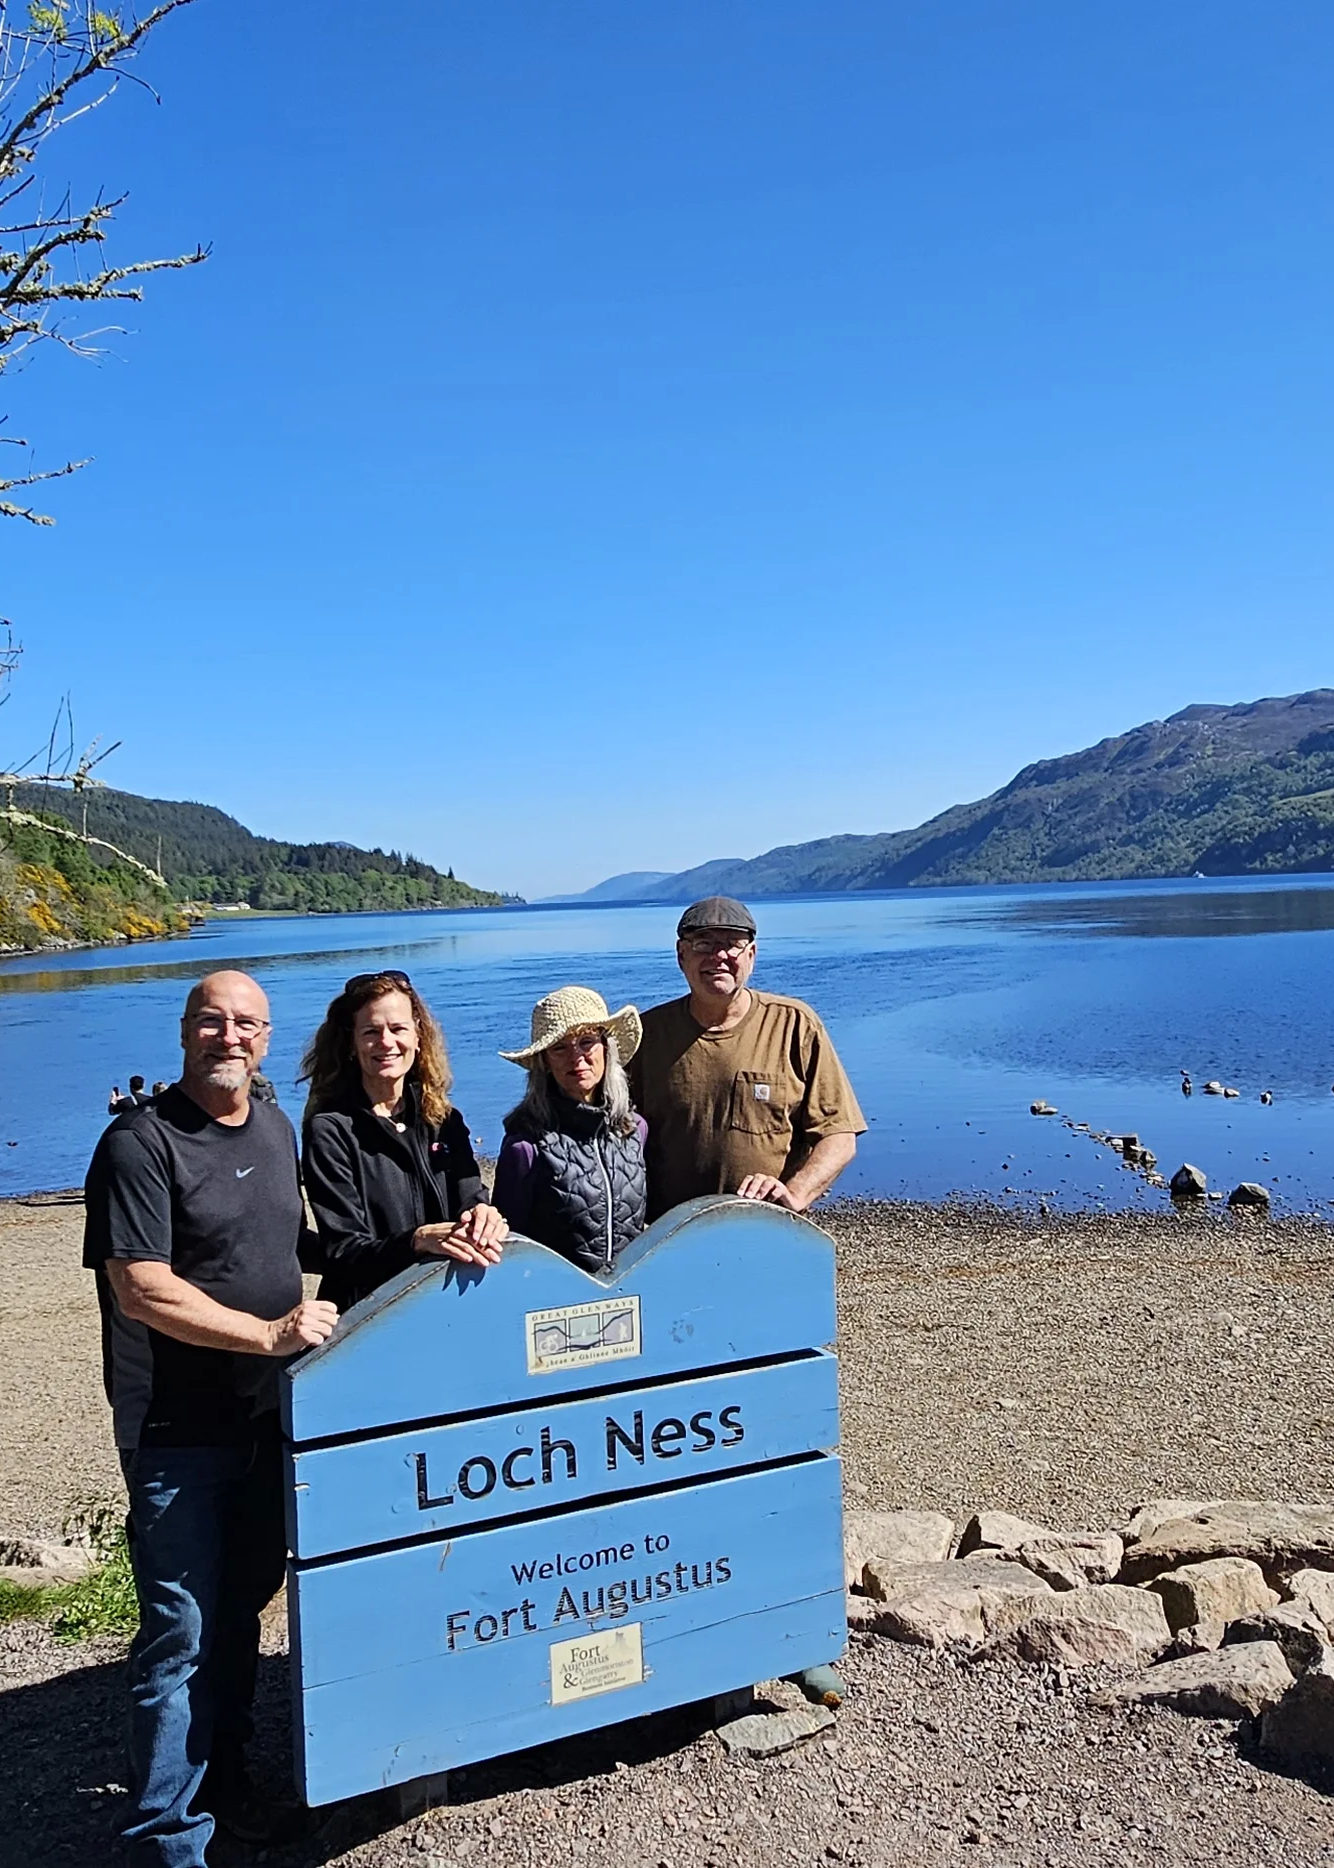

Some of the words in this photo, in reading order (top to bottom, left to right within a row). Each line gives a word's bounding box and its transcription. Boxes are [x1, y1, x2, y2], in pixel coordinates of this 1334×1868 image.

[532, 1310, 568, 1321] GREAT
[572, 1305, 601, 1315] GLEN
[606, 1300, 634, 1309] WAYS
[416, 1425, 577, 1511] Loch
[605, 1405, 746, 1471] Ness
[510, 1542, 635, 1586] Welcome
[643, 1533, 671, 1555] to
[446, 1599, 538, 1650] Fort
[552, 1557, 733, 1622] Augustus
[569, 1645, 601, 1663] Fort
[559, 1655, 610, 1675] Augustus
[563, 1672, 579, 1689] &
